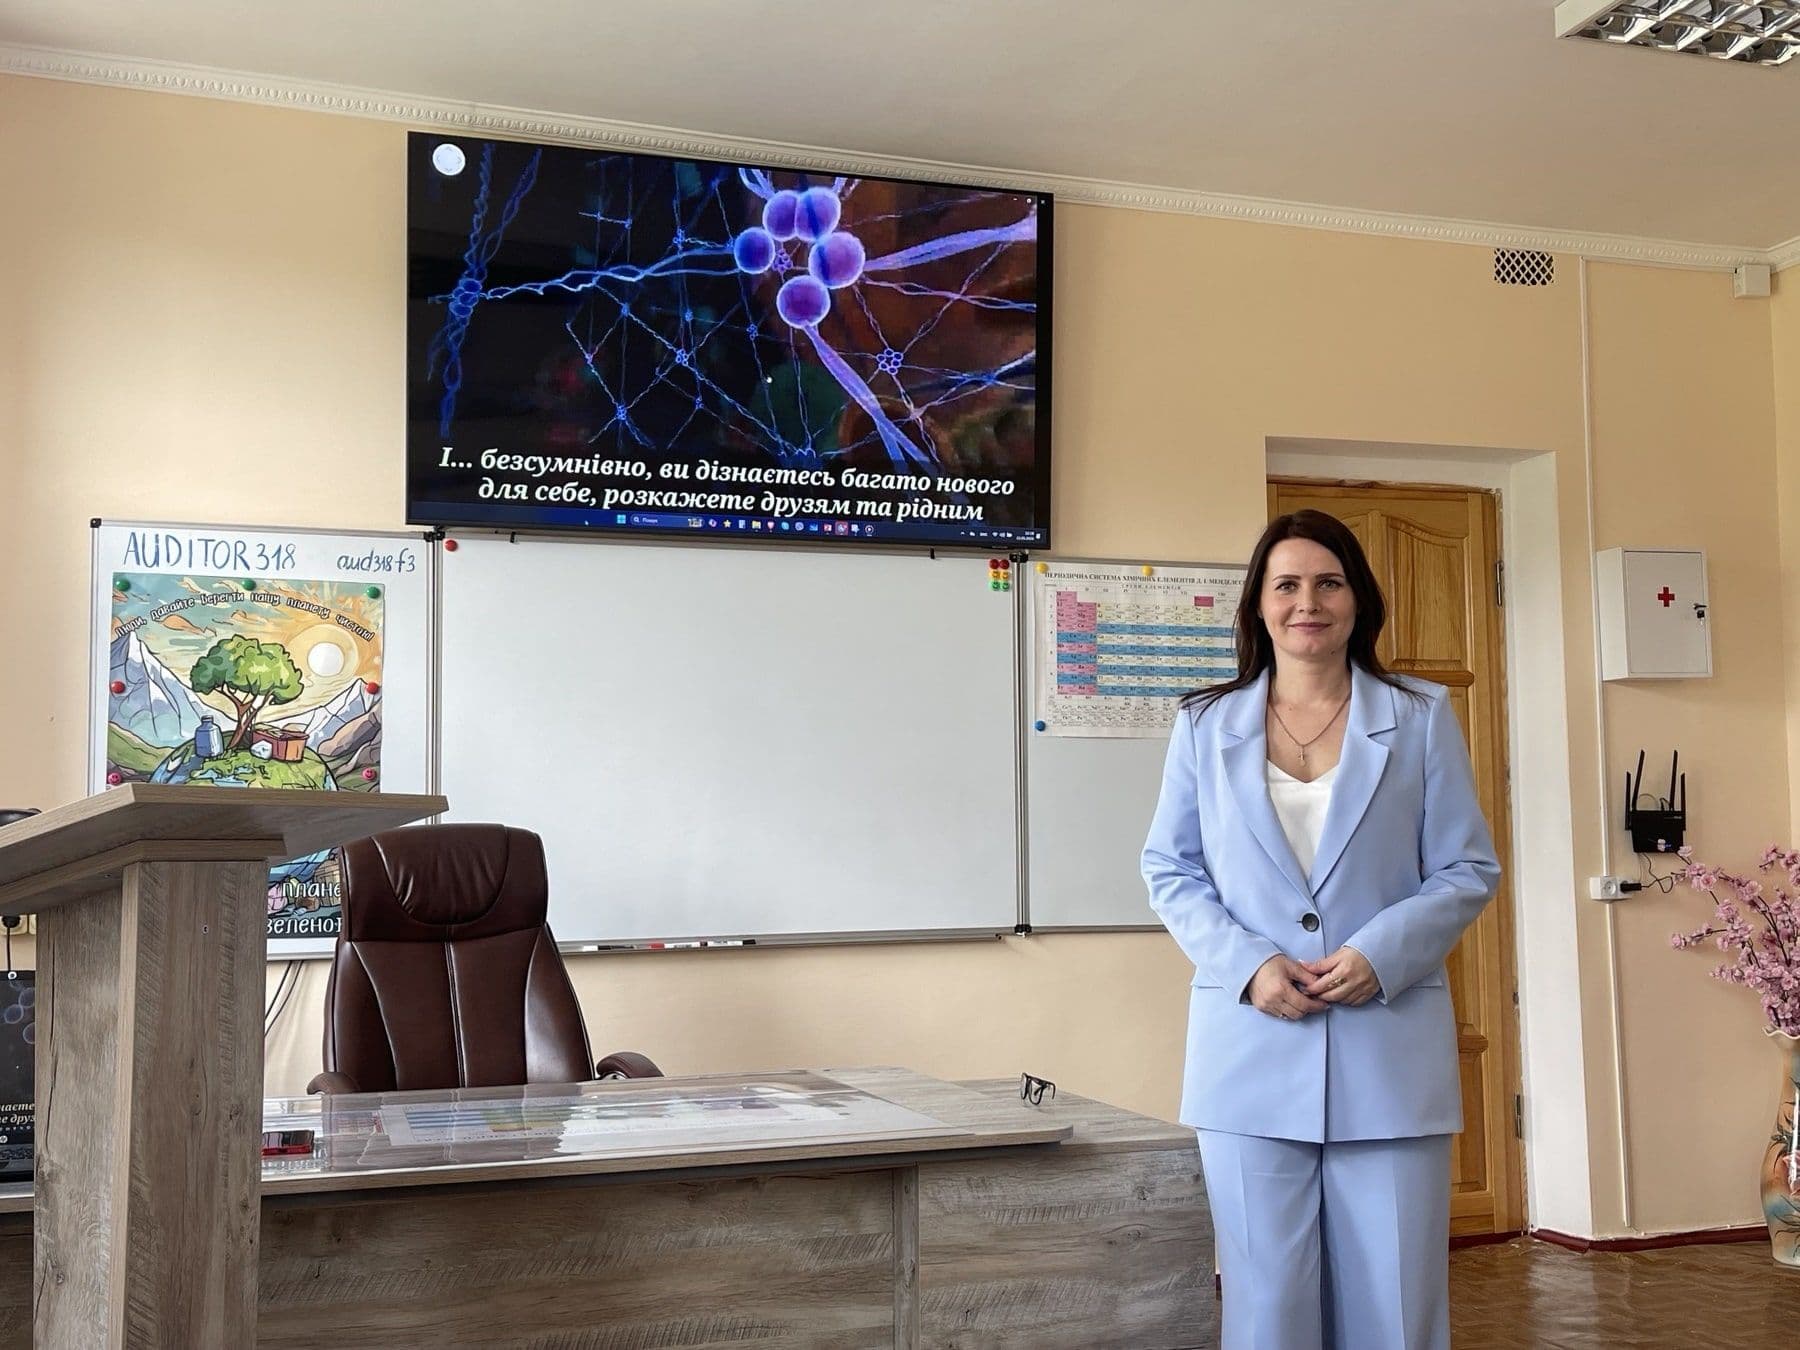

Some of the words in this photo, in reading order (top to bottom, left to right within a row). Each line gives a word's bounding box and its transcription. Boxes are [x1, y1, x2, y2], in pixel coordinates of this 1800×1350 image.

[480, 448, 652, 480] безсумнівно,
[660, 463, 690, 480] ви
[695, 460, 836, 487] дізнаєтесь
[841, 468, 931, 492] багато
[936, 476, 1015, 495] нового
[478, 477, 529, 500] для
[535, 481, 597, 506] себе,
[602, 488, 755, 511] розкажете
[761, 491, 850, 518] друзям
[856, 500, 892, 517] та
[896, 498, 984, 522] рідним
[150, 598, 195, 621] давайте
